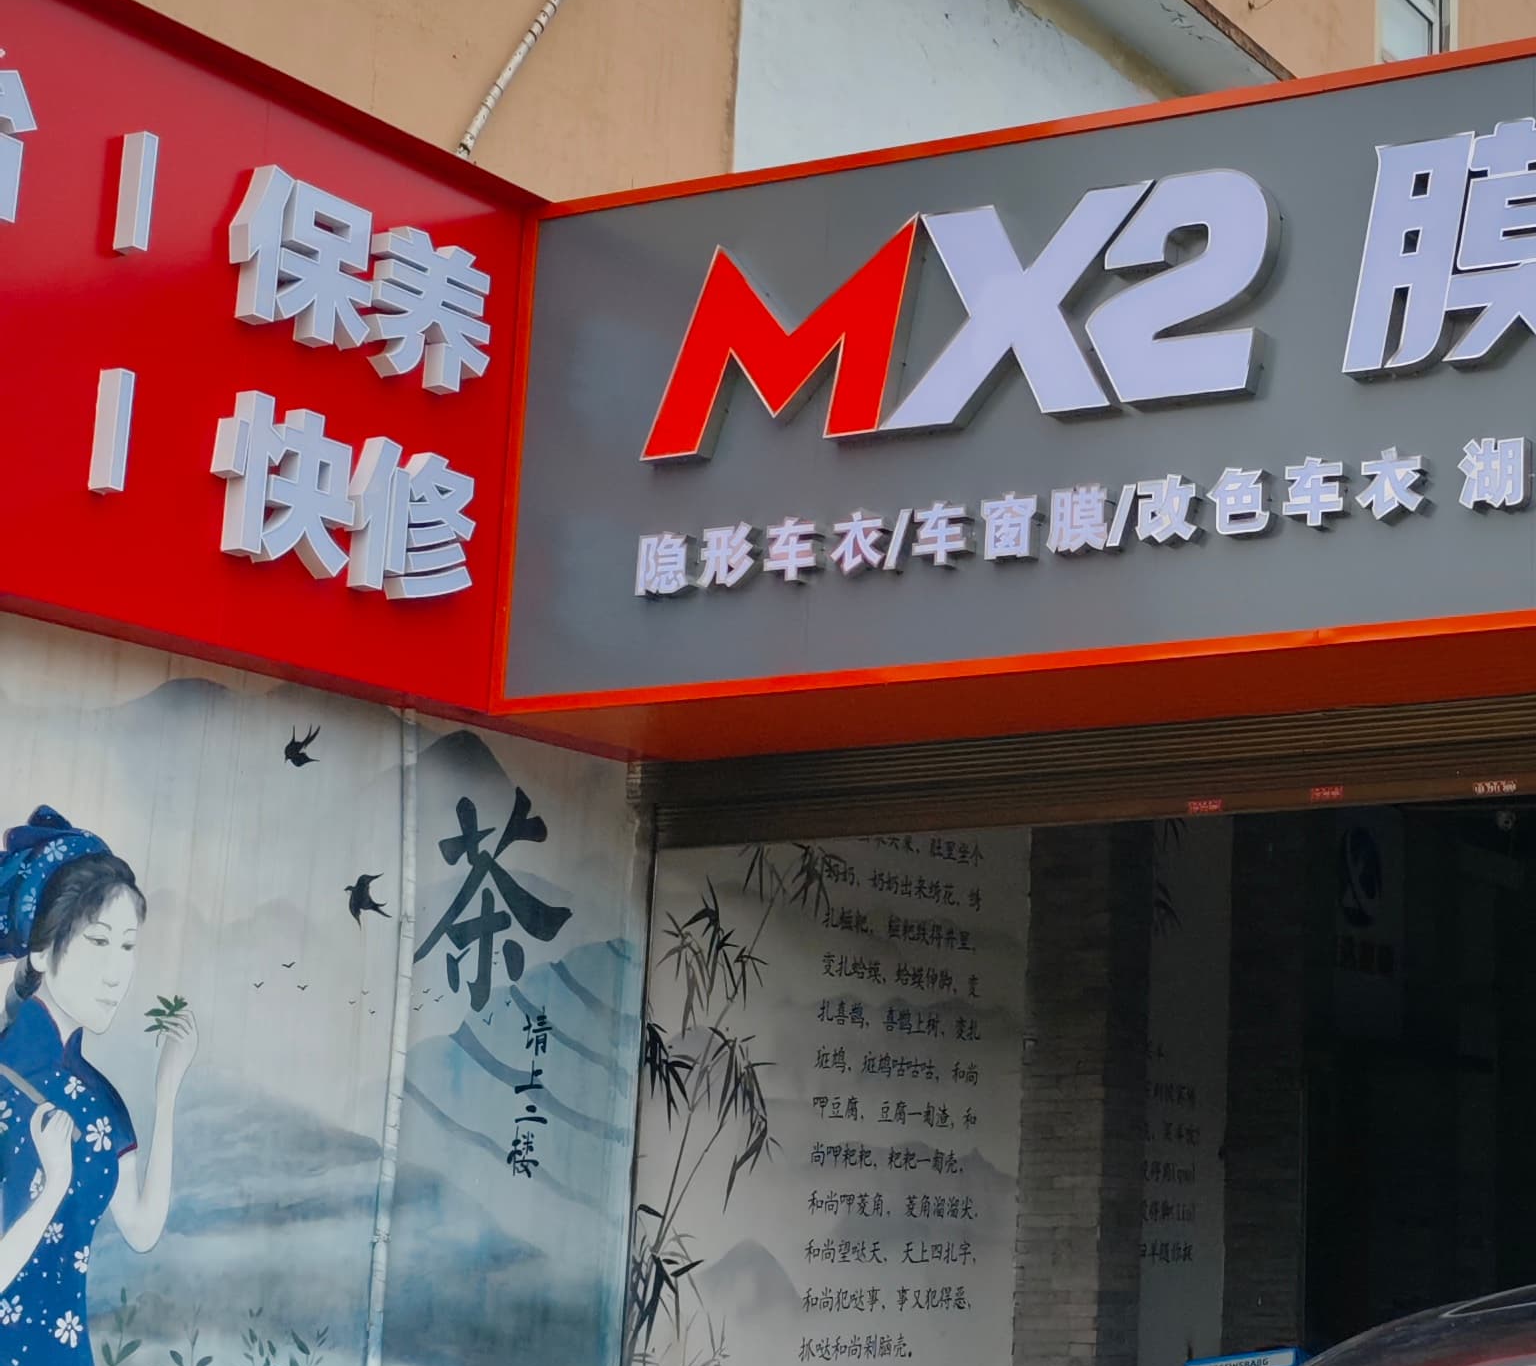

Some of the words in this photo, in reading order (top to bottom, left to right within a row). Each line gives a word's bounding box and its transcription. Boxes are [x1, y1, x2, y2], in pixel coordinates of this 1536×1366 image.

[229, 165, 490, 394] 保养
[639, 169, 1278, 464] MX2
[210, 390, 476, 599] 快修
[412, 787, 573, 1013] 茶
